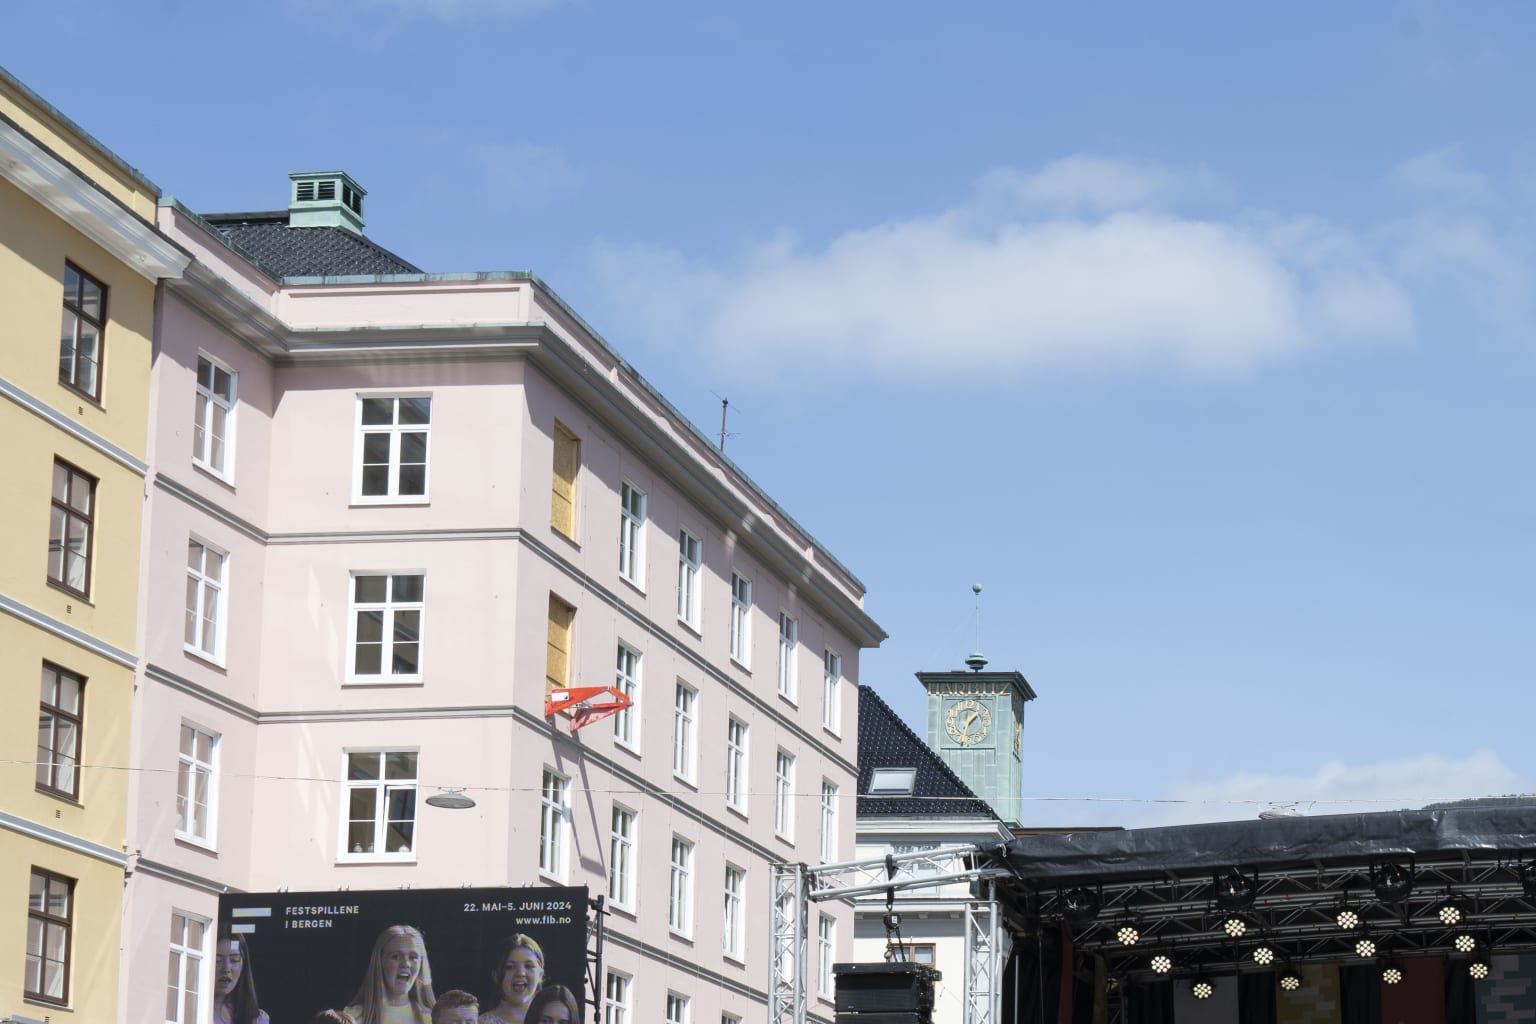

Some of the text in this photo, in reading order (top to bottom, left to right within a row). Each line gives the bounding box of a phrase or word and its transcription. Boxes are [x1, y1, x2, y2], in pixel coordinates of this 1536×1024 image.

[927, 682, 1010, 695] HARBITZ
[285, 905, 360, 916] FESTSPILLENE
[463, 903, 479, 912] 22.
[519, 901, 544, 910] JUNI
[546, 901, 572, 910] 2024
[291, 919, 333, 929] BERGEN
